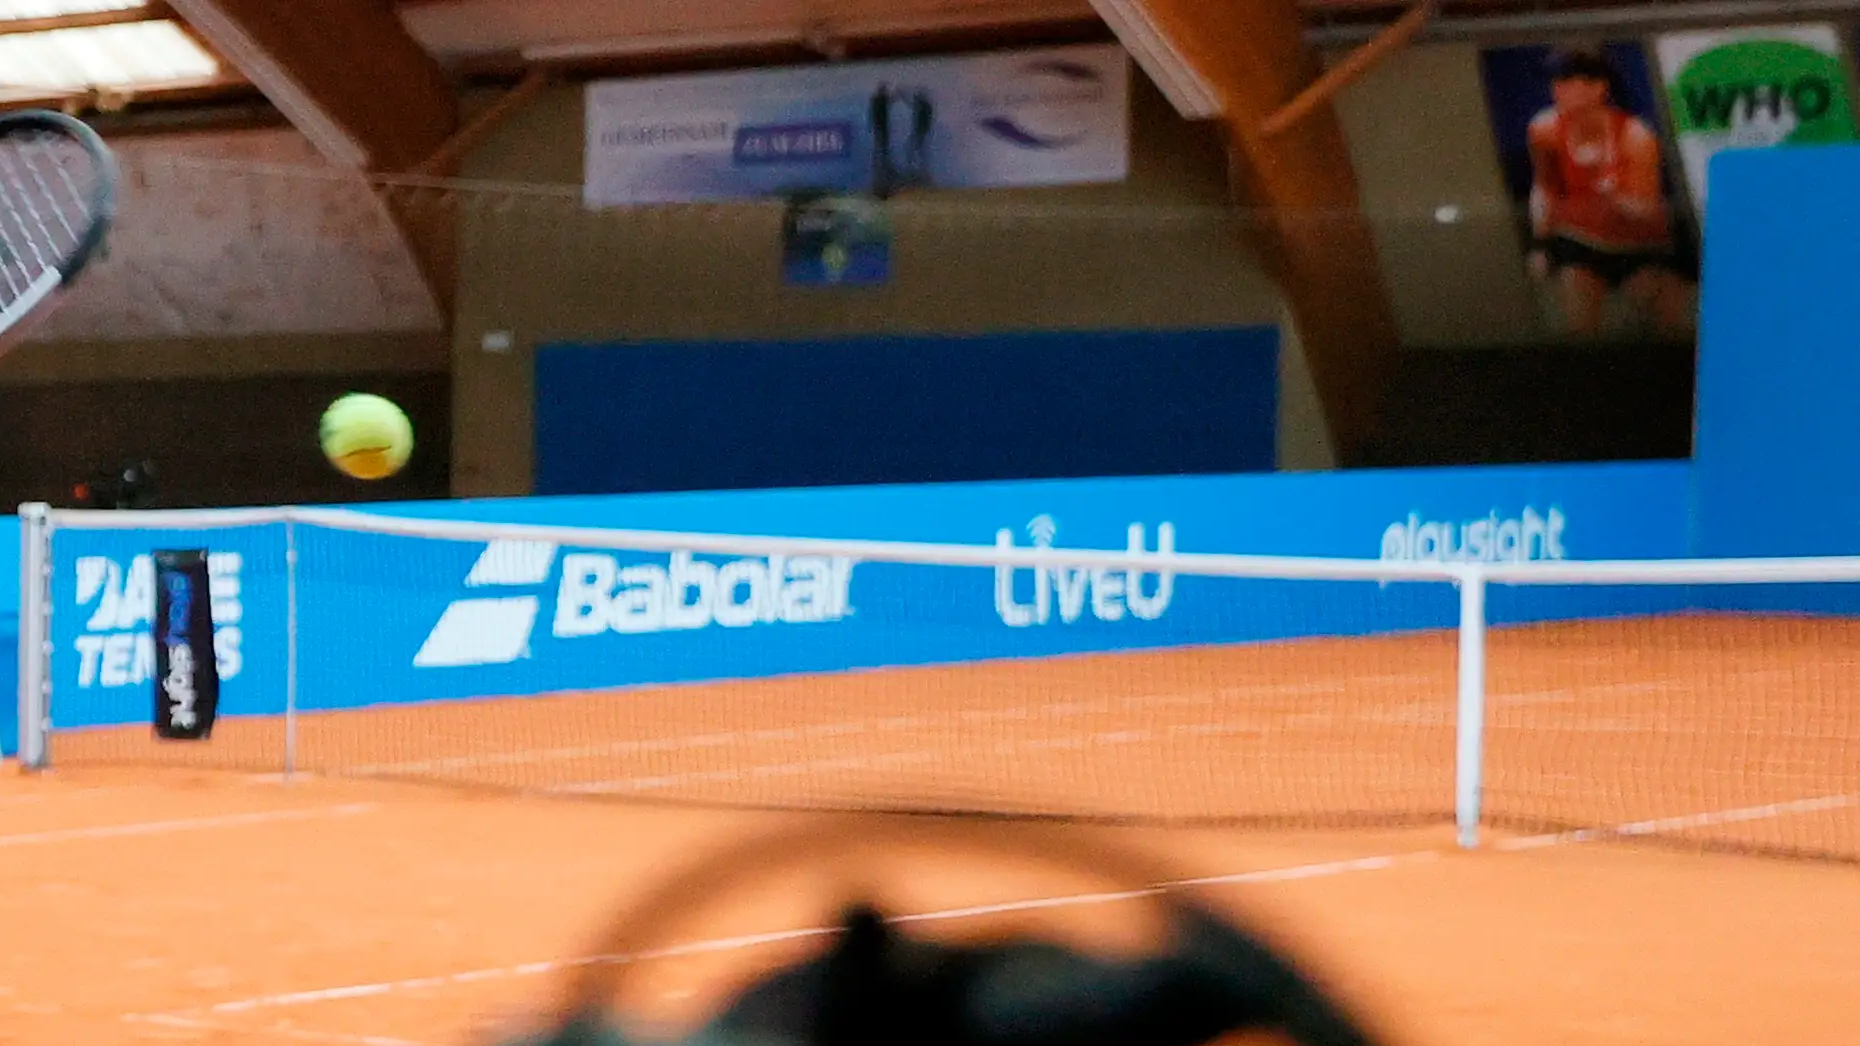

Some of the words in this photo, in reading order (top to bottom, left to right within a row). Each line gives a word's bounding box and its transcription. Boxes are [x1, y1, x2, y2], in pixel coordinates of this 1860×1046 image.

[1686, 77, 1832, 129] WHO
[76, 552, 242, 631] BAE
[75, 626, 242, 689] TENS
